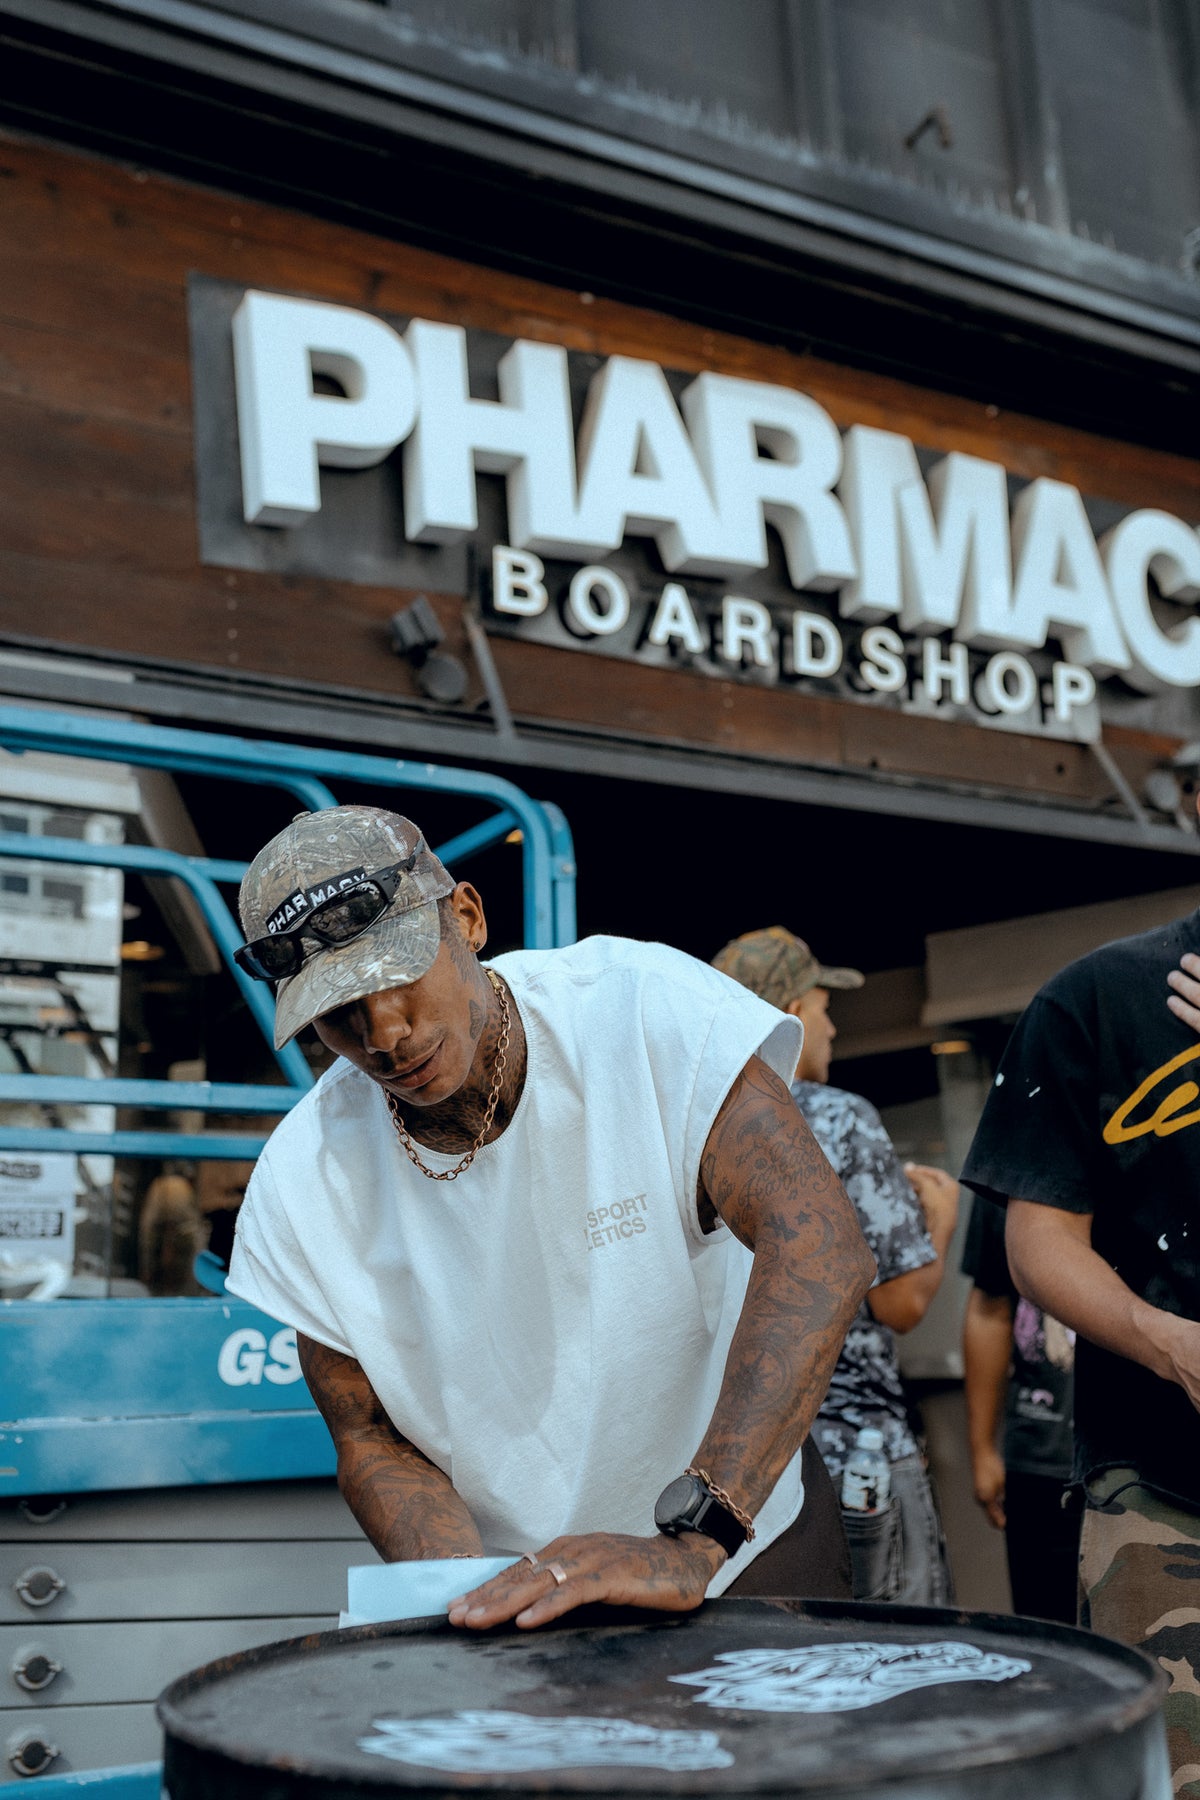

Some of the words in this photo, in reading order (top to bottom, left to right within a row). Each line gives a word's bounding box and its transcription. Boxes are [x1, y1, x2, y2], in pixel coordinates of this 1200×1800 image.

[233, 290, 1200, 688] PHARMAC
[492, 545, 1096, 721] BOARDSHOP
[586, 1193, 647, 1228] SPORT
[217, 1327, 302, 1386] GS
